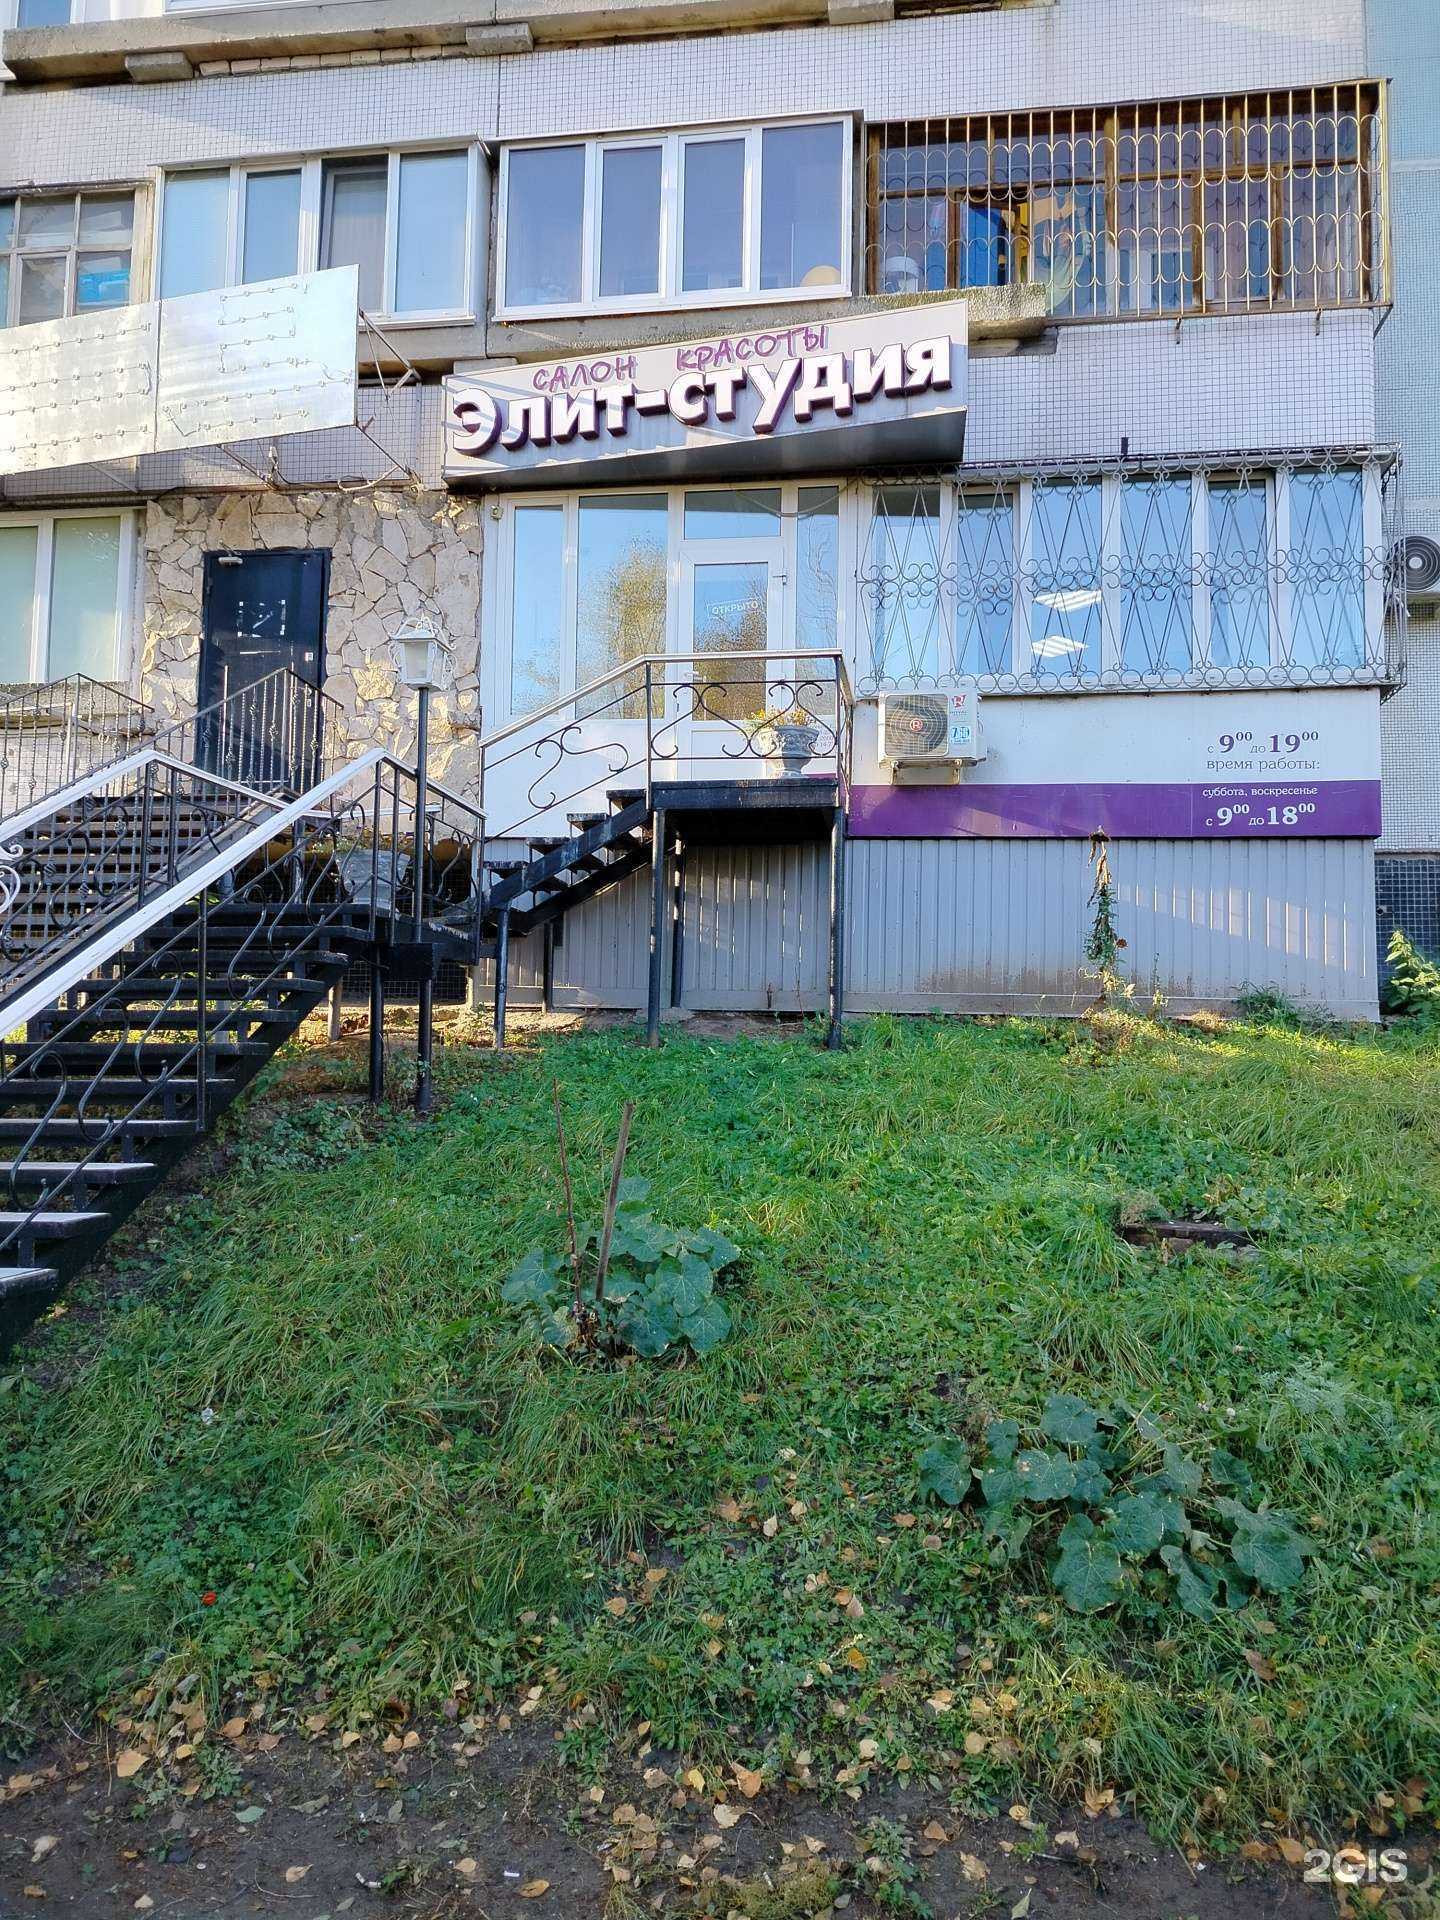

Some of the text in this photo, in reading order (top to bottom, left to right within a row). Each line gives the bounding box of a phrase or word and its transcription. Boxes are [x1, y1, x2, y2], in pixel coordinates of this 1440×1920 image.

[532, 324, 828, 393] САЛОН КРАСОТЫ
[711, 600, 758, 615] ОТКРЫТО
[1206, 745, 1215, 754] с
[1249, 745, 1266, 754] до
[1206, 757, 1320, 772] время работы:
[1202, 787, 1318, 799] суббота, воскресенье
[1205, 818, 1213, 826] с
[1248, 817, 1265, 826] до
